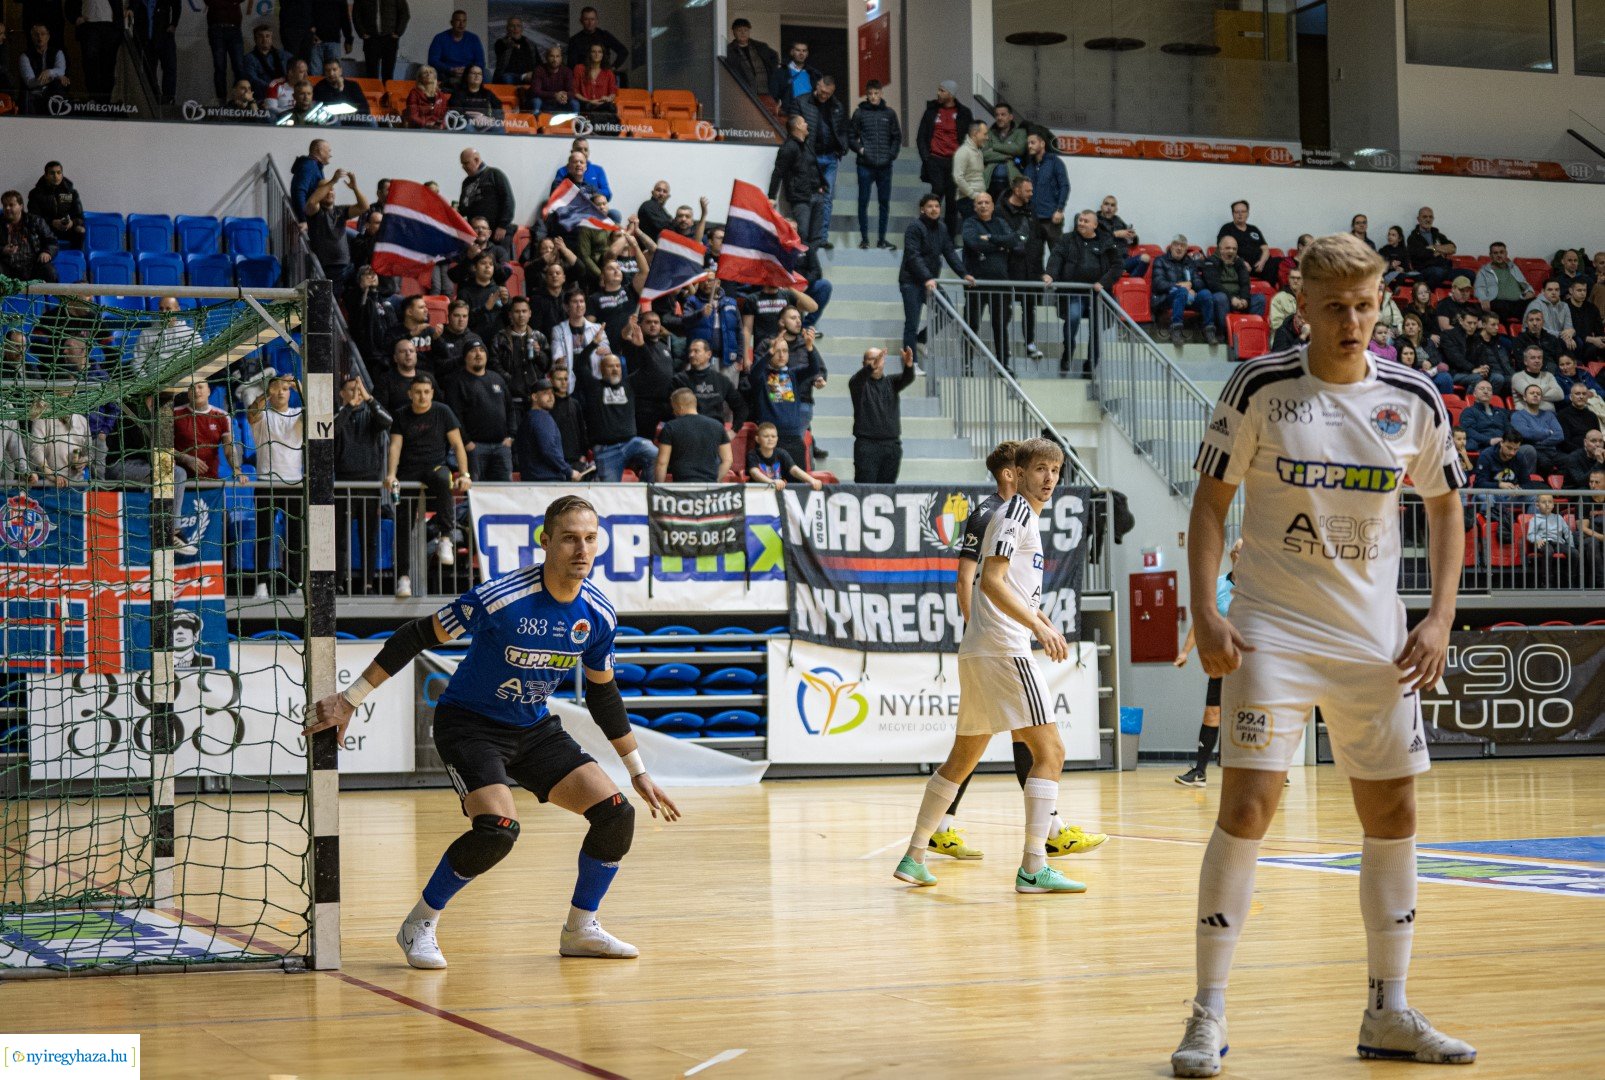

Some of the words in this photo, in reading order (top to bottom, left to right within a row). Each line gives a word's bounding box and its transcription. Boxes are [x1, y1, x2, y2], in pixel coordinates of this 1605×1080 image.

[73, 101, 139, 114] NYÍREGYHÁZA
[207, 106, 271, 118] NYÍREGYHÁZA
[469, 116, 530, 129] NYÍREGYHÁZA
[594, 121, 654, 134] NYÍREGYHÁZA
[718, 127, 776, 140] NYÍREGYHÁZA
[1268, 397, 1313, 425] 383
[652, 491, 743, 516] mastiffs
[1283, 536, 1379, 561] STUDIO
[516, 617, 549, 637] 383
[1237, 711, 1266, 727] 99.4
[1420, 698, 1574, 730] TUDIO
[1241, 731, 1257, 743] FM
